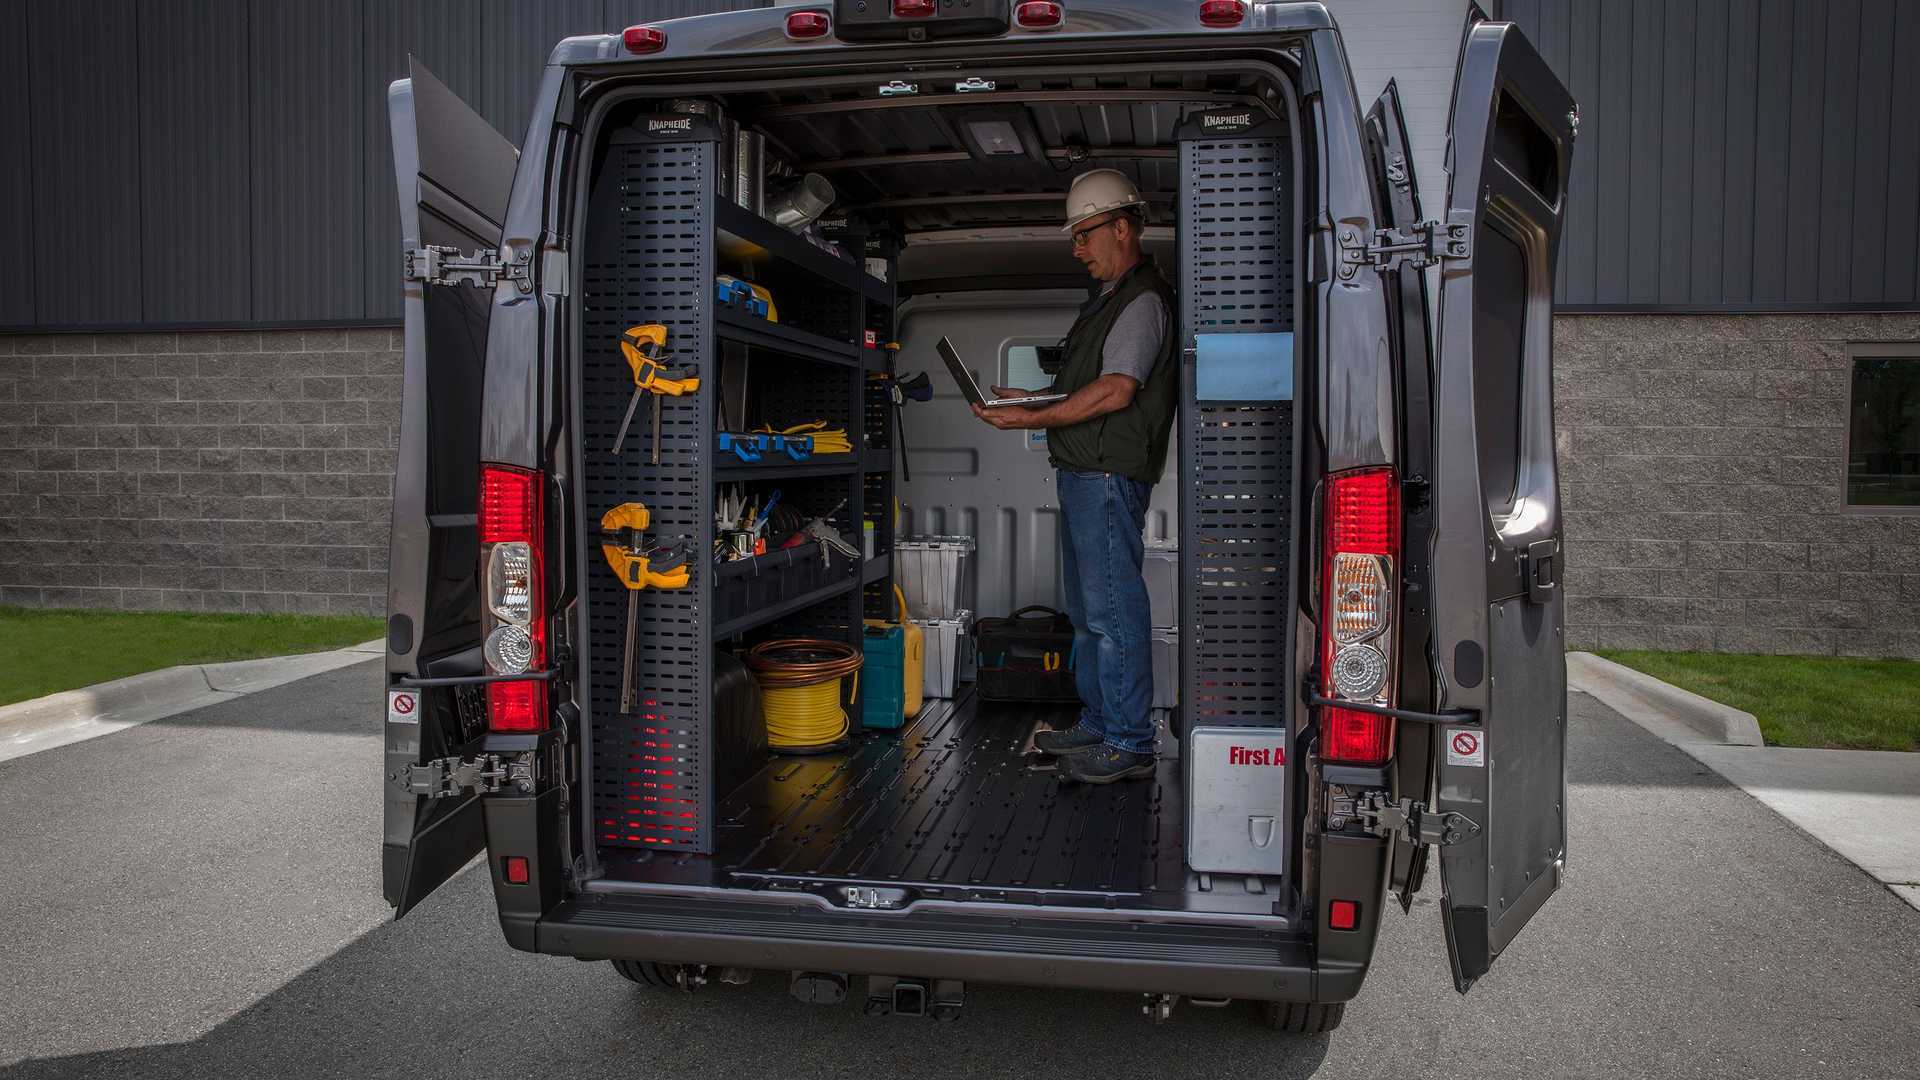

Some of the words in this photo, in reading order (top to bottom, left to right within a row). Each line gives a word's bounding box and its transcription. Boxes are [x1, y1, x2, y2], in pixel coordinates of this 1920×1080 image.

[648, 118, 692, 131] KNAPHEIDE
[1204, 114, 1250, 127] KNAPHEIDE
[1229, 746, 1270, 766] First
[1273, 747, 1286, 766] A
